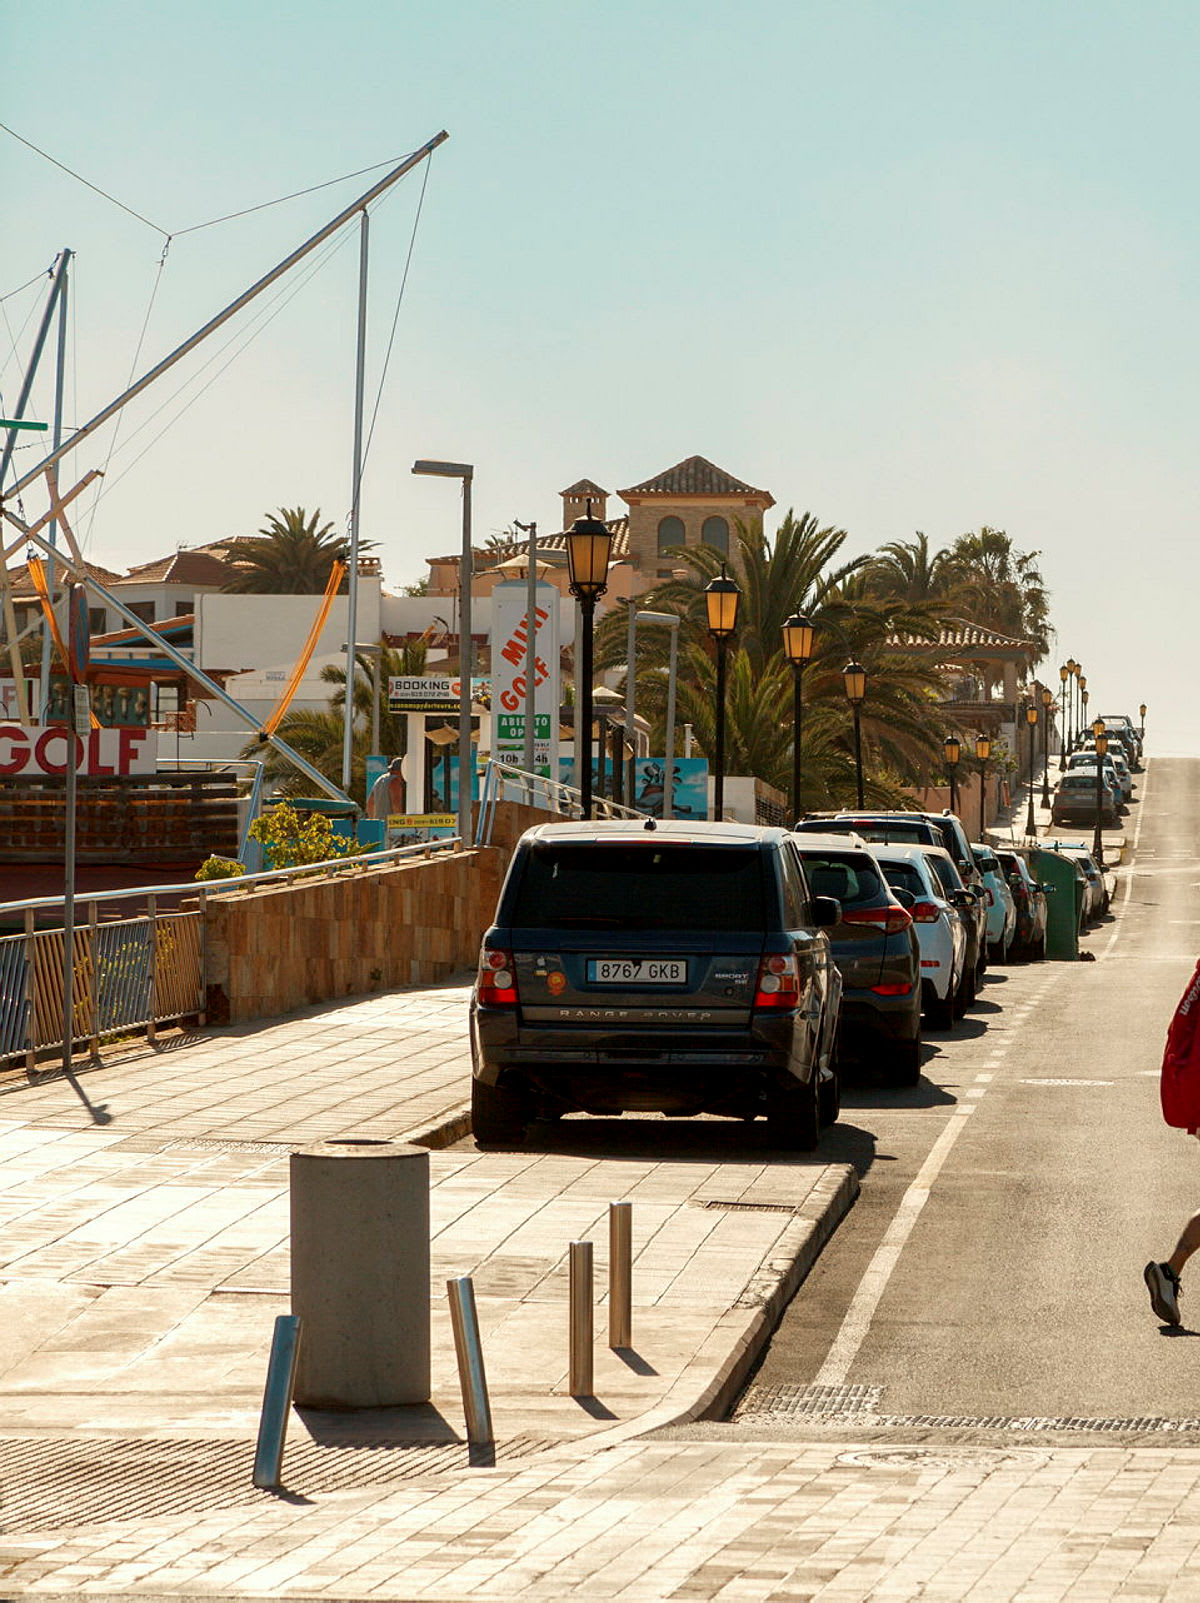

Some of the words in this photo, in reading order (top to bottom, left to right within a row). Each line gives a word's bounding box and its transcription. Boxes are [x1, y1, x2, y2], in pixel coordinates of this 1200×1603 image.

[500, 606, 549, 667] MINI
[394, 681, 450, 690] BOOKING
[499, 656, 550, 712] GOLF
[501, 717, 548, 726] ABIETO
[509, 728, 539, 737] OPN
[0, 727, 147, 775] GOLF
[499, 754, 519, 763] 10h
[601, 963, 642, 979] 8767
[648, 963, 680, 979] GKB
[559, 1010, 628, 1018] RANGE
